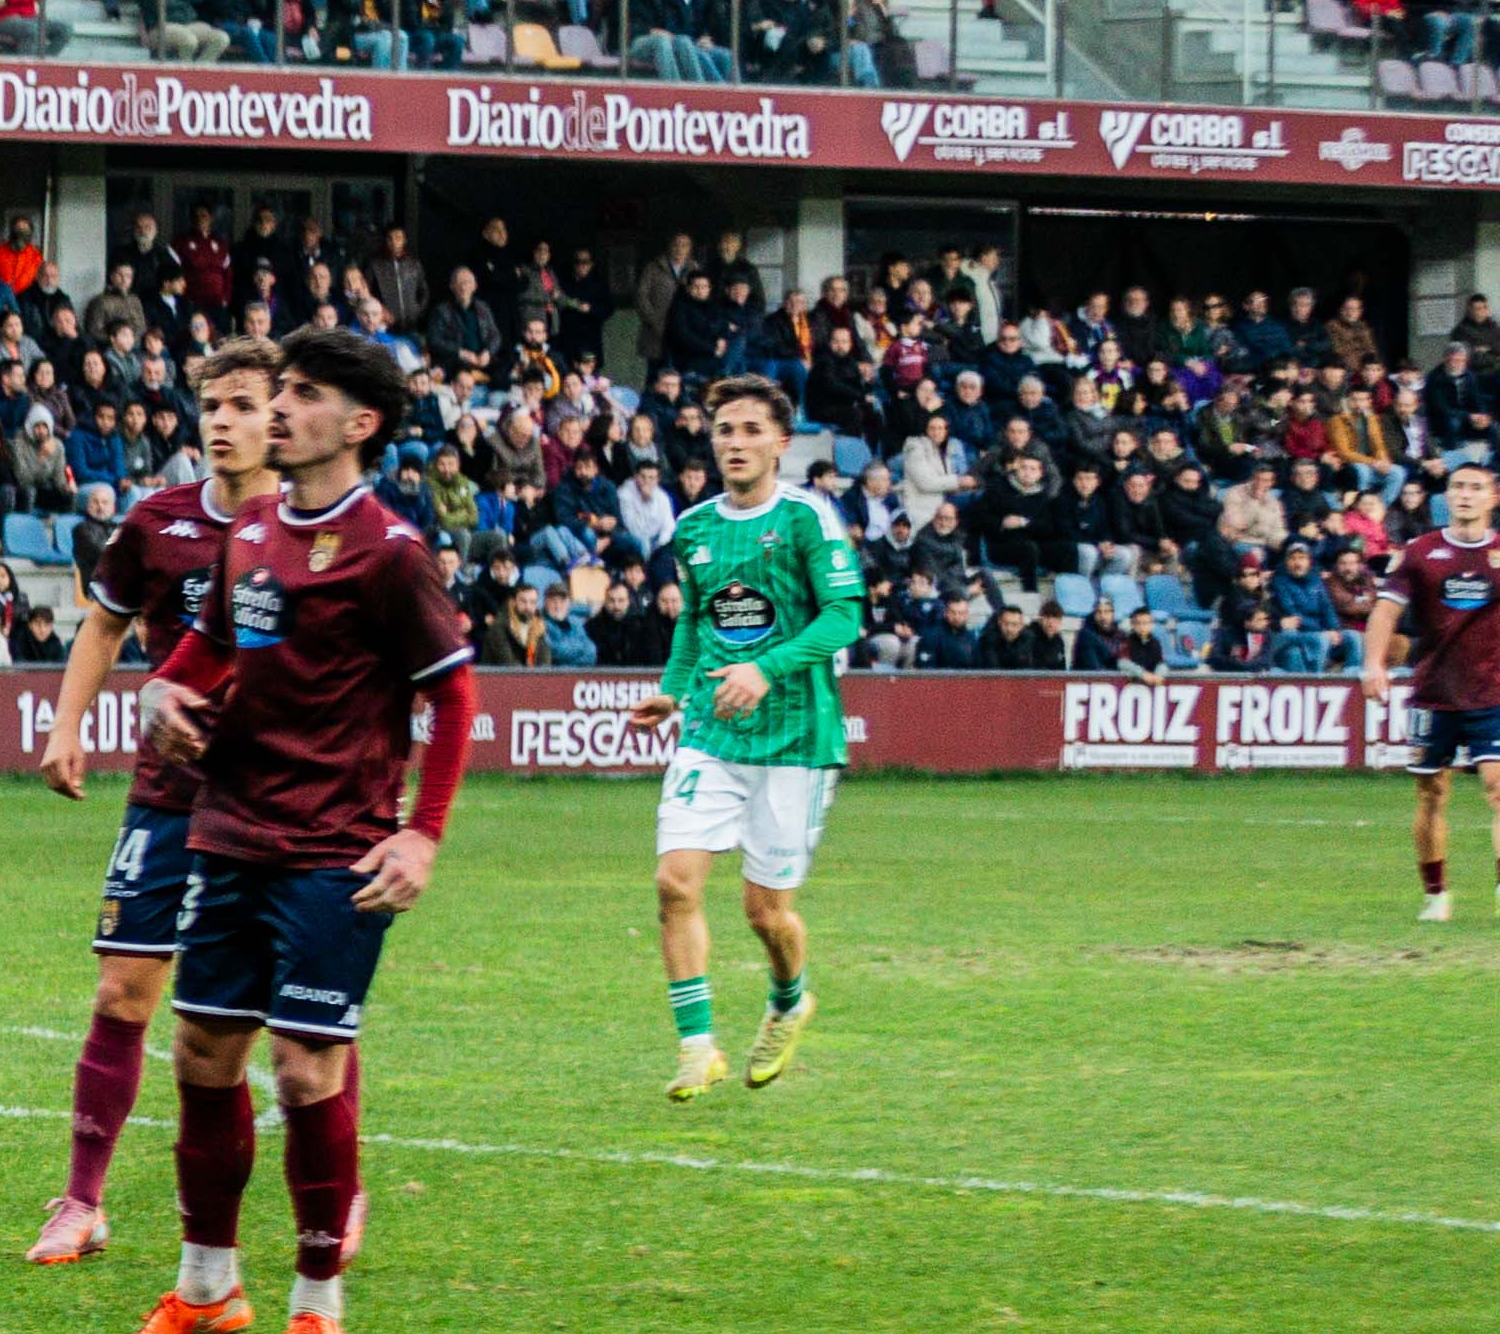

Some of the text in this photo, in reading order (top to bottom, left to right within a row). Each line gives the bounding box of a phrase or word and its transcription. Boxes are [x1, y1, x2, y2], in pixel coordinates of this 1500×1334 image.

[157, 77, 373, 142] Pontevedra
[448, 86, 565, 148] Diario
[604, 93, 811, 158] Pontevedra
[934, 105, 1029, 139] CORBA
[1149, 114, 1242, 148] CORBA
[1403, 142, 1500, 184] PESCA
[17, 690, 55, 754] 1ª
[1063, 683, 1202, 743] FROIZ
[1216, 685, 1353, 744] FROIZ
